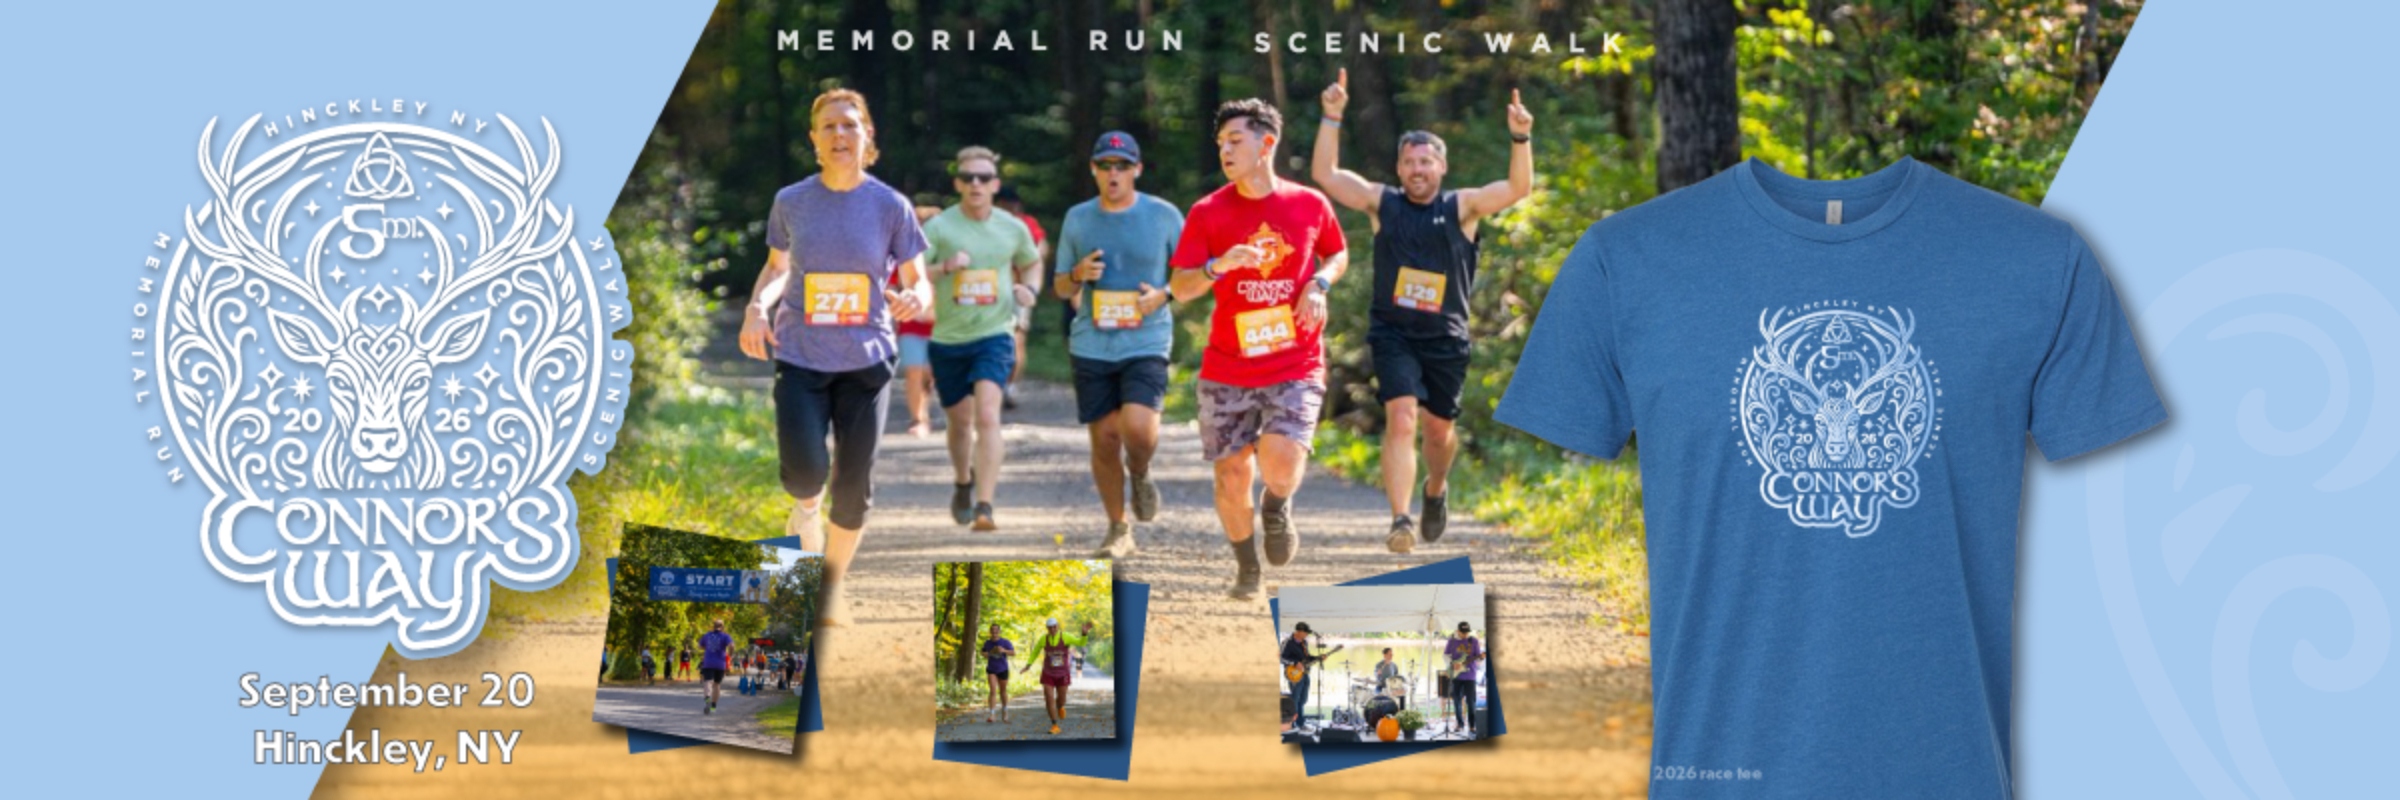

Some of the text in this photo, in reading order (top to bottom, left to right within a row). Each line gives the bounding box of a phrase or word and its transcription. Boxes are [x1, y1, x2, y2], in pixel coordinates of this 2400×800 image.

[1404, 284, 1437, 301] 129
[814, 293, 859, 311] 271
[1100, 304, 1136, 319] 235
[1245, 321, 1288, 344] 444
[1796, 433, 1813, 444] 20
[1796, 494, 1878, 530] WAY
[685, 574, 734, 586] START
